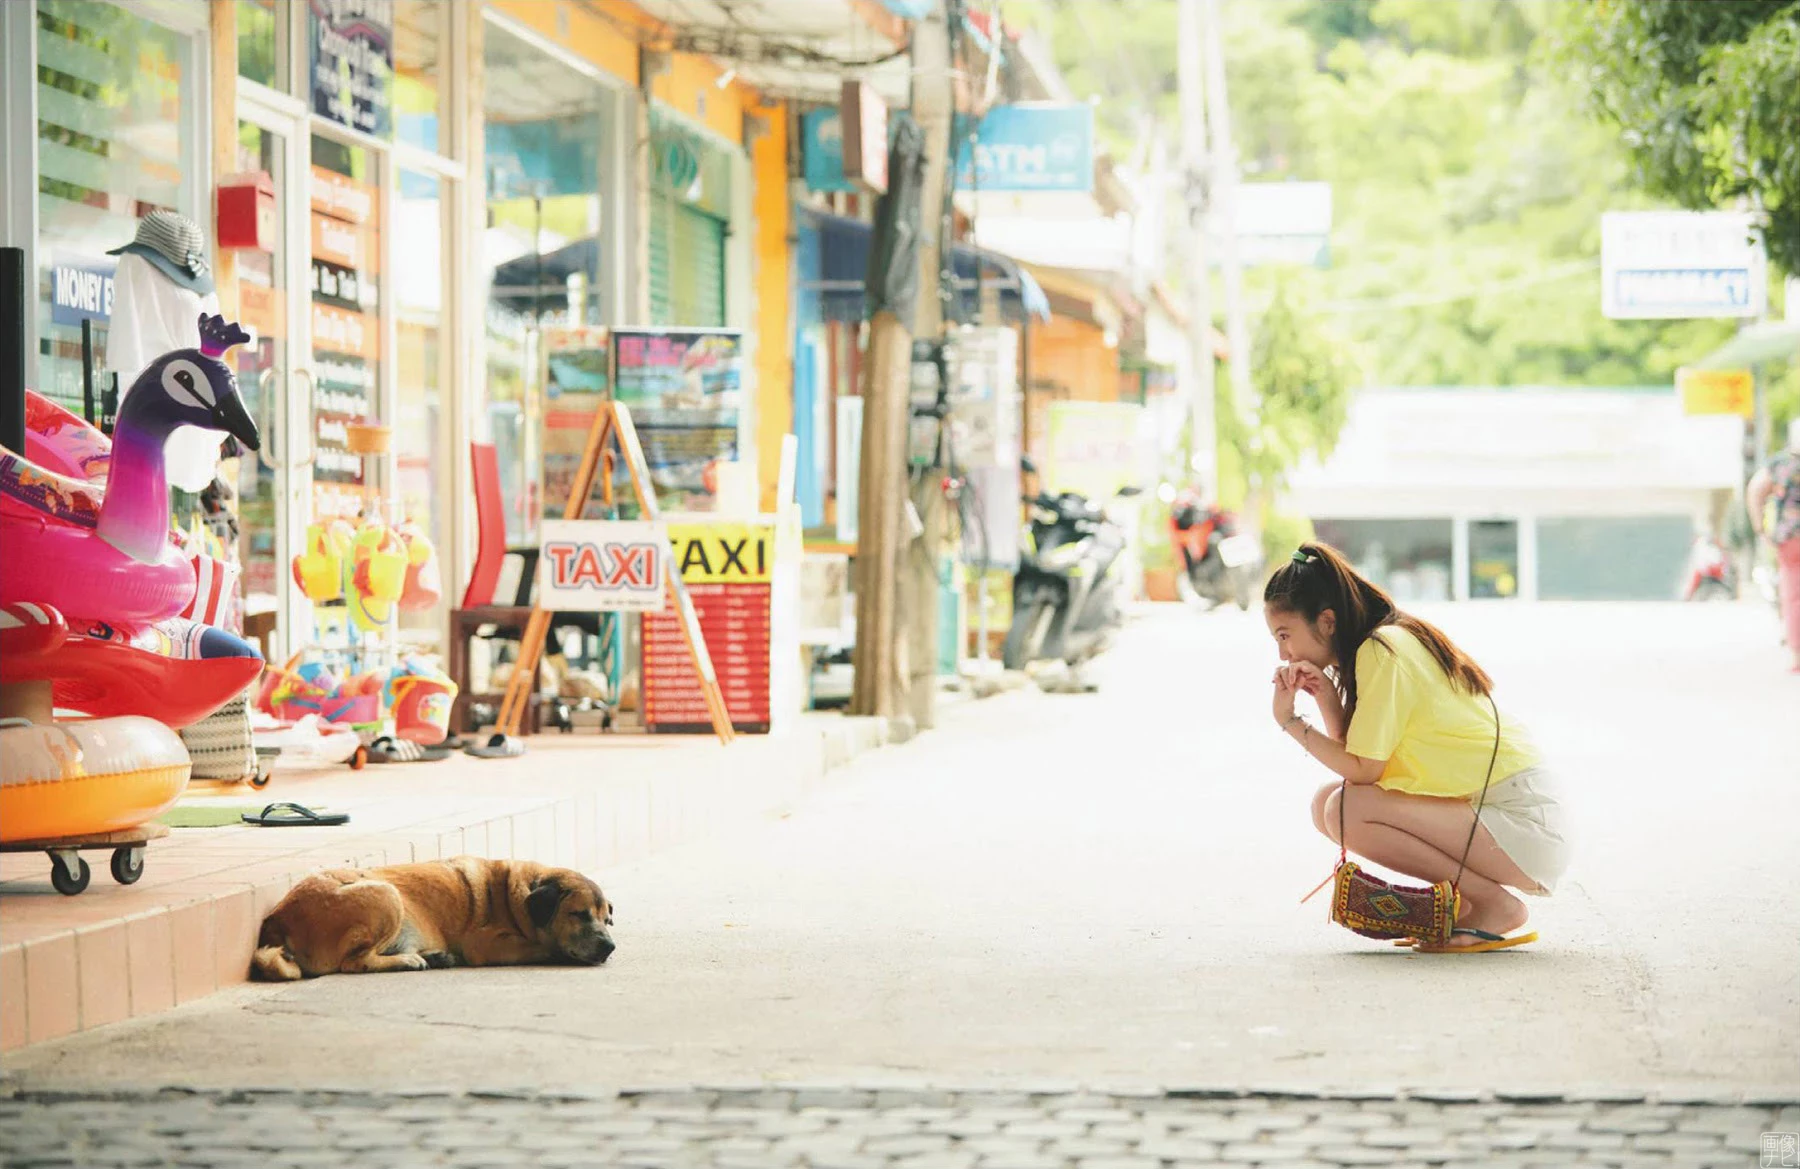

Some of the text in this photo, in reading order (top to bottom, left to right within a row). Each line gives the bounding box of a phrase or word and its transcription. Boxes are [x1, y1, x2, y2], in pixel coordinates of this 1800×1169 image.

[967, 144, 1046, 172] ATM
[56, 266, 102, 313] MONEY
[548, 544, 657, 588] TAXI
[670, 538, 765, 576] AXI
